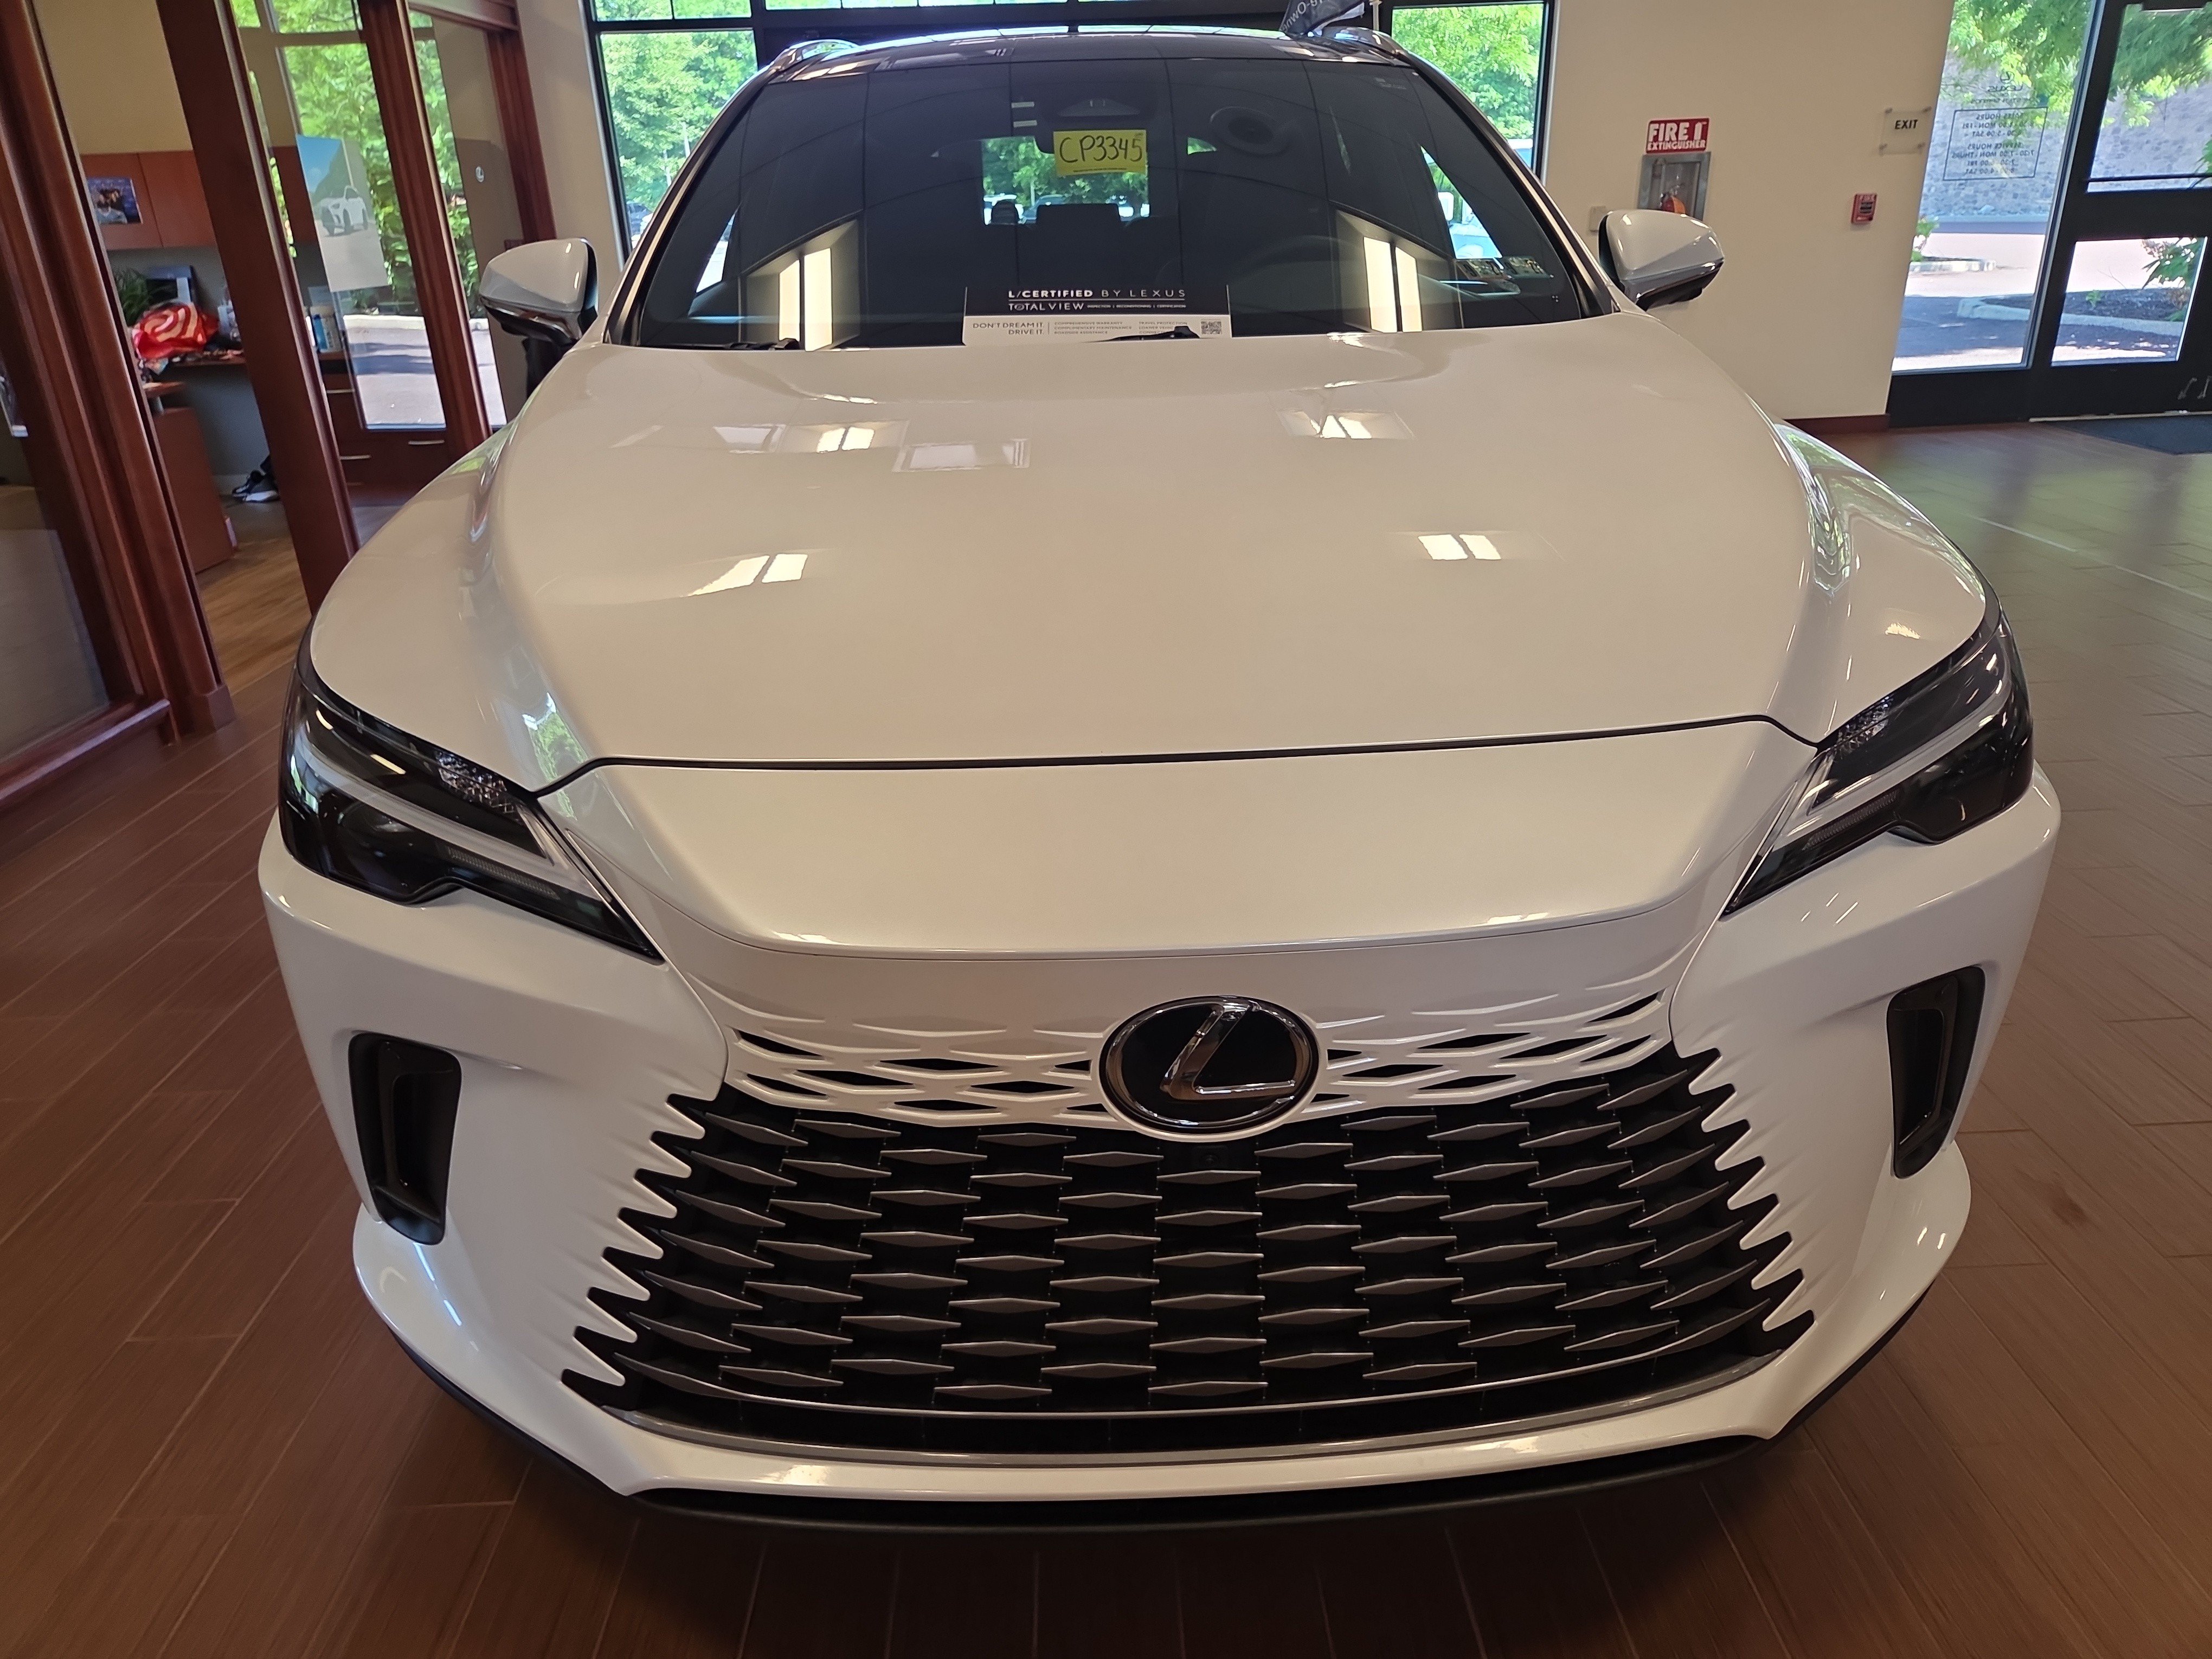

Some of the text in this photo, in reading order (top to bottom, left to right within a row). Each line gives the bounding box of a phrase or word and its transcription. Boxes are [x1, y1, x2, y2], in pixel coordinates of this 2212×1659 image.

[1894, 119, 1918, 130] EXIT
[1648, 122, 1690, 142] FIRE
[1059, 134, 1143, 163] CP3345
[1647, 139, 1706, 151] EXTINGUISHER
[1008, 289, 1186, 298] L/CERTIFIED BY LEXUS
[1008, 303, 1084, 311] TOTAL VIEW
